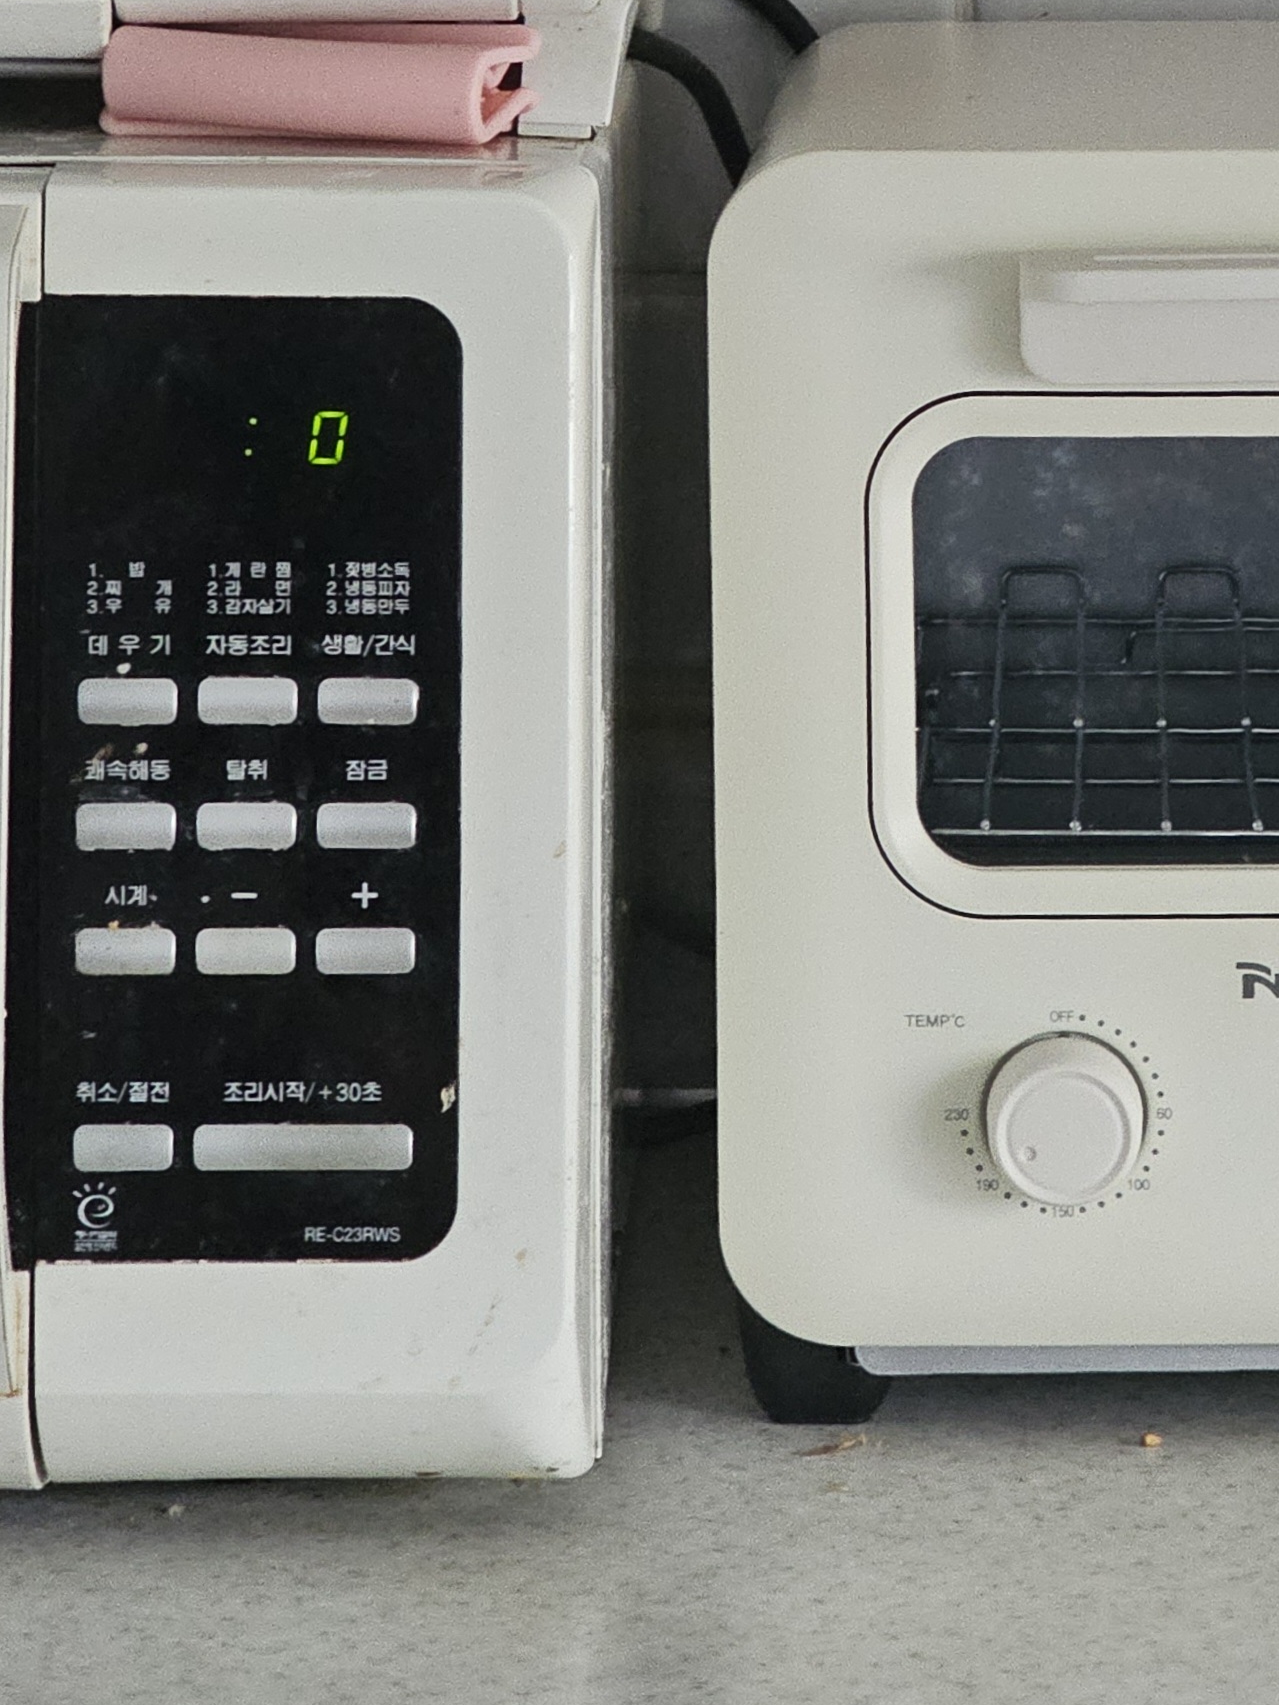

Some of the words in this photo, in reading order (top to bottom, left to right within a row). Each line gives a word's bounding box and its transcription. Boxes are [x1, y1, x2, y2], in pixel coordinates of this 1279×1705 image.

[308, 410, 349, 465] 0
[206, 634, 293, 656] 자동조리
[322, 634, 416, 657] 생활/간식
[226, 759, 268, 781] 탈취
[345, 759, 388, 781] 잠금
[105, 885, 148, 906] 시계
[1050, 1010, 1074, 1022] OFF
[76, 1081, 170, 1104] 취소/절전
[944, 1108, 969, 1121] 230
[1128, 1179, 1150, 1191] 100
[304, 1227, 401, 1242] RE-C23RWS
